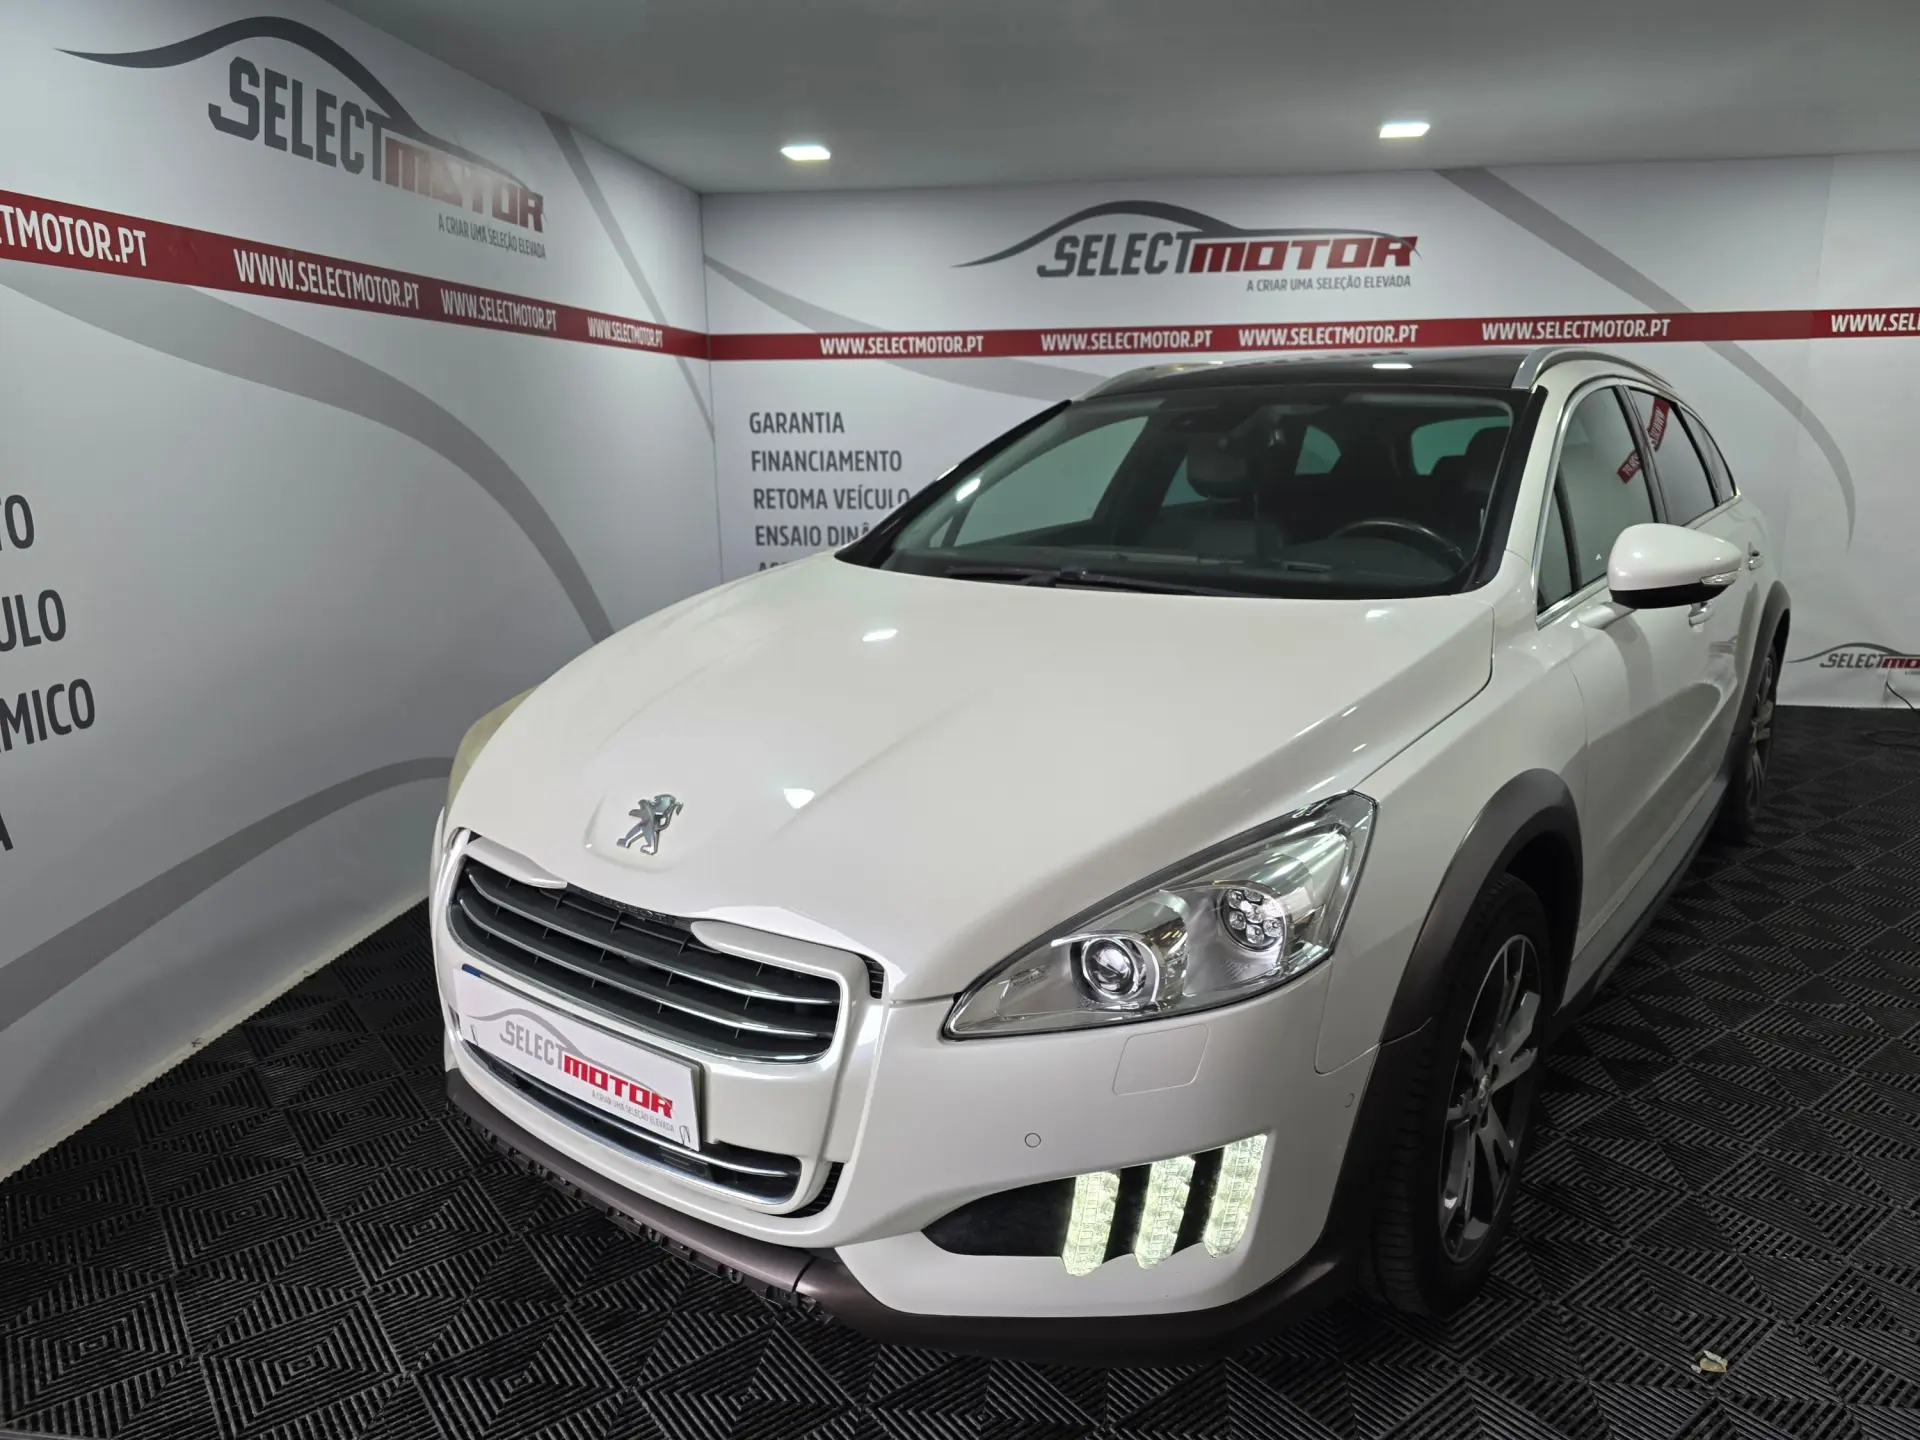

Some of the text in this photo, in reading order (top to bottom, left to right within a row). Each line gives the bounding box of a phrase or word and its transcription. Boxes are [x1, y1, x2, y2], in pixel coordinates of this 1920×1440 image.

[438, 213, 547, 260] A CRIAR UMA SELEÇÃO ELEVADA
[1036, 231, 1419, 277] SELECTMOTOR
[0, 203, 663, 348] TMOTOR.PT WWW.SELECTMOTOR.PT WWW.SELECTMOTOR.PT WWW.SELECTMOTOR.PT
[1246, 275, 1412, 292] A CRIAR UMA SELEÇÃO ELEVADA
[820, 313, 1920, 355] WWW.SELECTMOTOR.PT WWW.SELECTMOTOR.PT WWW.SELECTMOTOR.PT WWW.SELECTMOTOR.PT WWW.SEL
[749, 411, 845, 434] GARANTIA
[751, 450, 902, 472] FINANCIAMENTO
[753, 484, 910, 510] RETOMA VEÍCULO
[0, 494, 34, 551] O
[755, 525, 822, 547] ENSAIO
[0, 679, 95, 753] MICO
[500, 1020, 673, 1119] SELECTMOTOR
